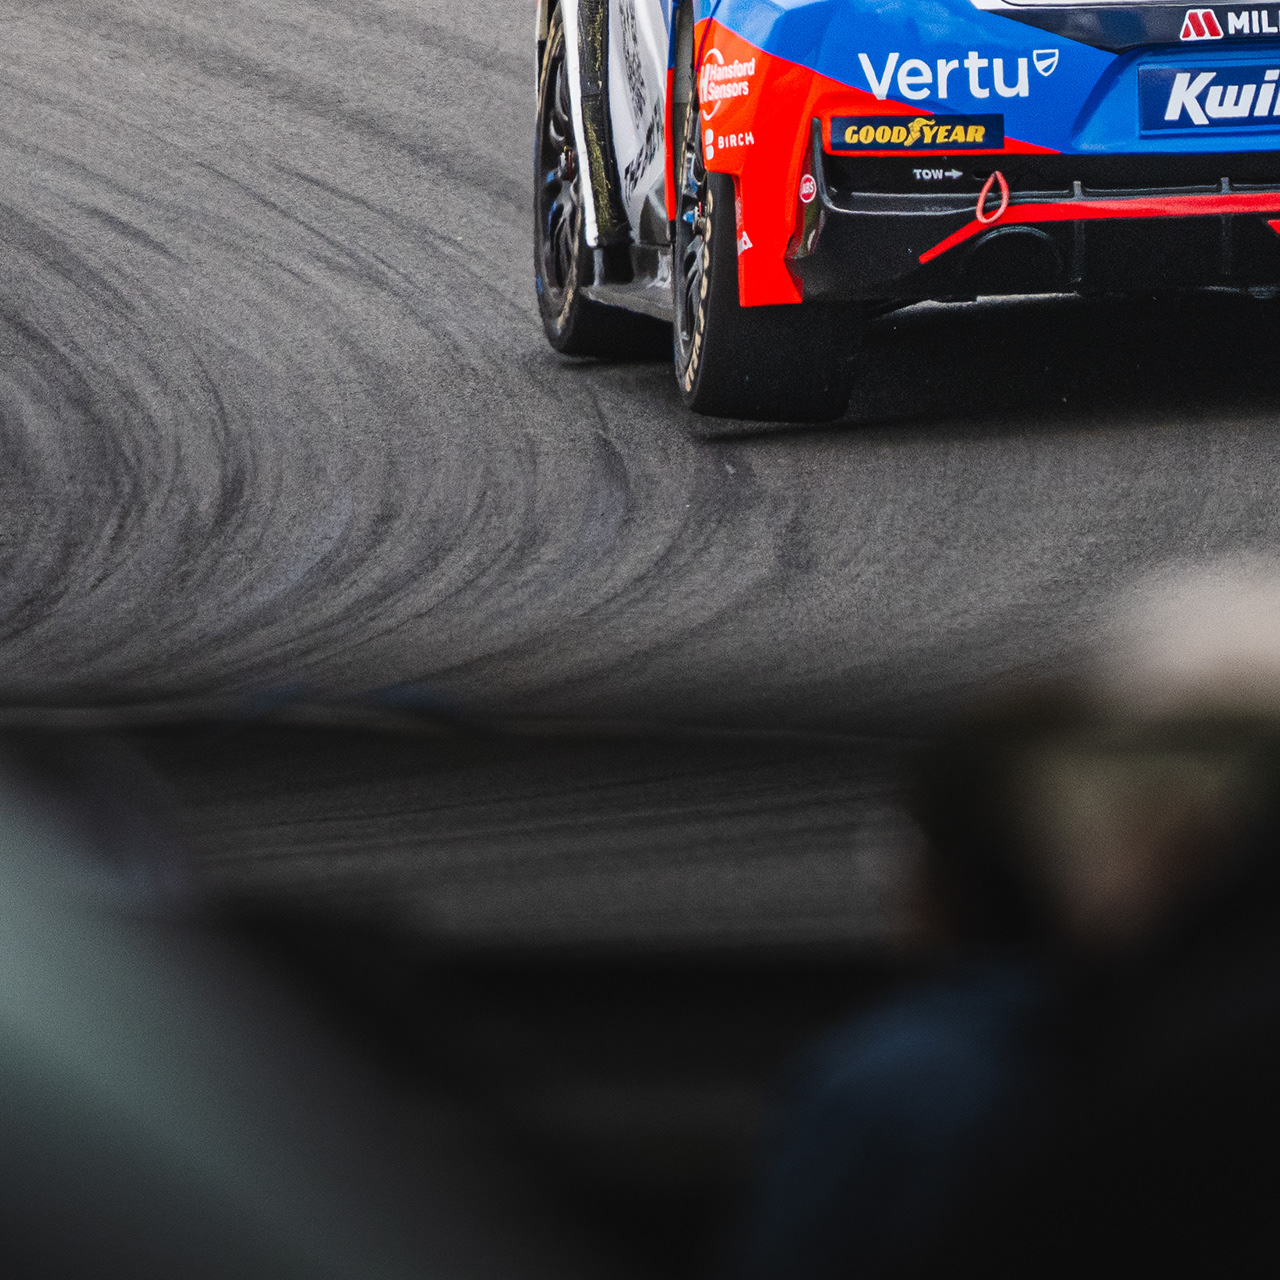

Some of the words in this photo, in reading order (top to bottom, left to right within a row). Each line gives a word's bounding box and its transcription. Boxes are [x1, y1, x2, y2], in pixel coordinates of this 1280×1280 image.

[709, 57, 756, 81] Hansford
[858, 51, 1030, 100] Vertu
[709, 81, 749, 101] Sensors
[718, 131, 755, 149] BIRCH
[914, 168, 943, 180] TOW
